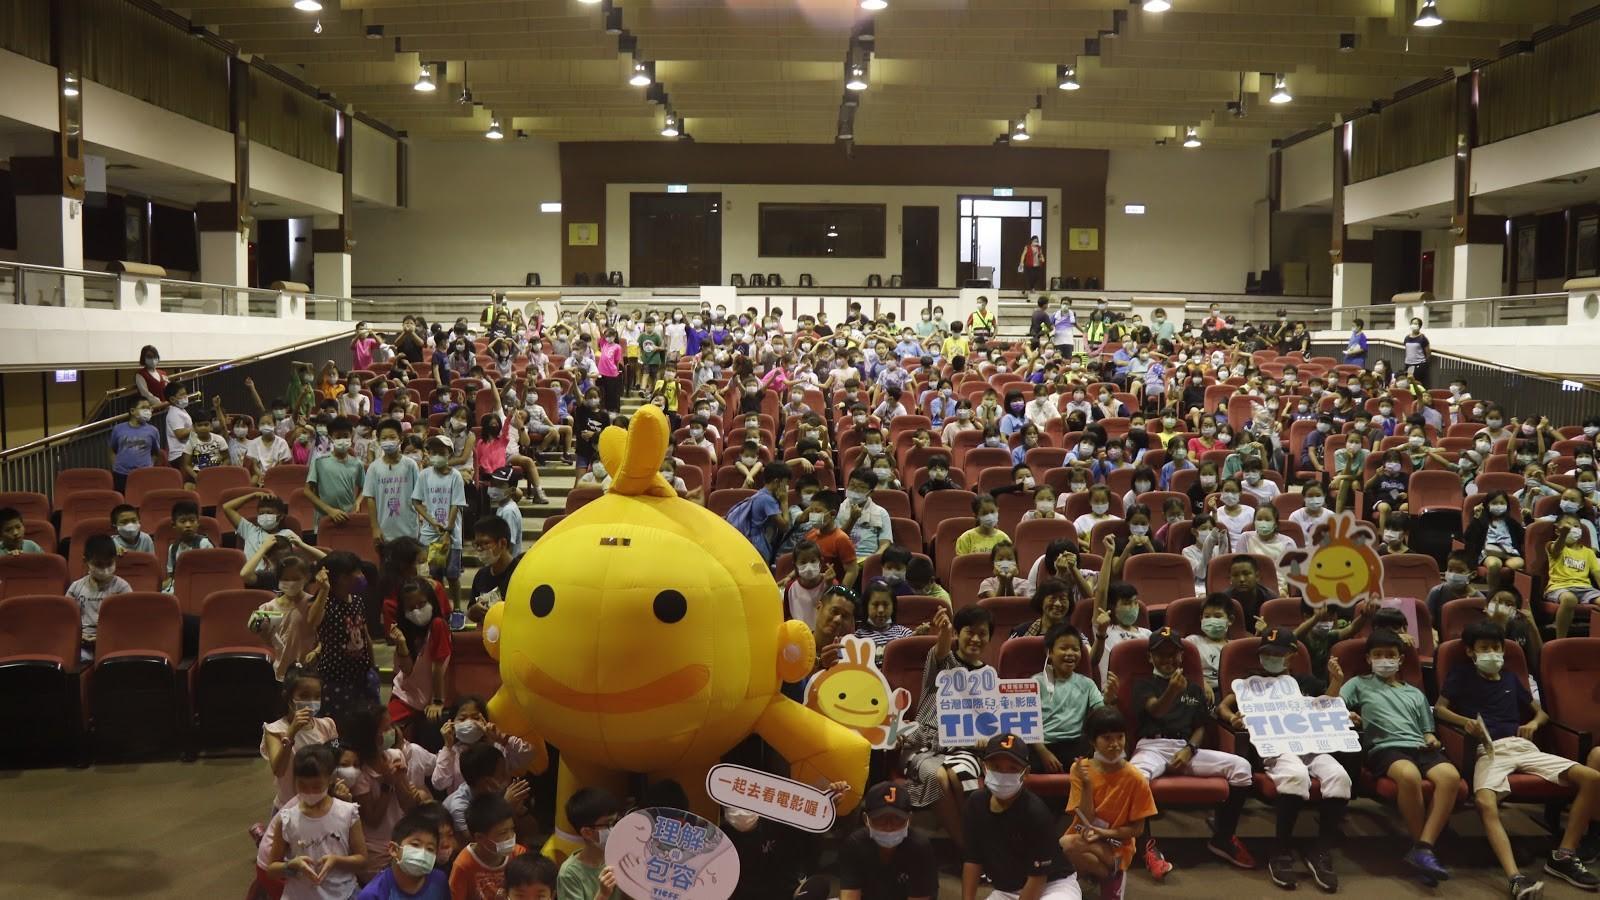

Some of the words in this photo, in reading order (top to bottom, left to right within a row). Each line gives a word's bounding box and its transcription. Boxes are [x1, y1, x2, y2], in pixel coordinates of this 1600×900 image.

[1161, 627, 1171, 636] J
[1267, 629, 1278, 642] J
[939, 669, 996, 697] 2020
[1236, 677, 1296, 701] 2020
[940, 711, 1038, 736] TICFF
[1246, 711, 1350, 736] TICFF
[1000, 735, 1015, 749] J
[884, 787, 897, 803] J
[652, 816, 707, 852] 理解
[646, 856, 696, 890] 包容
